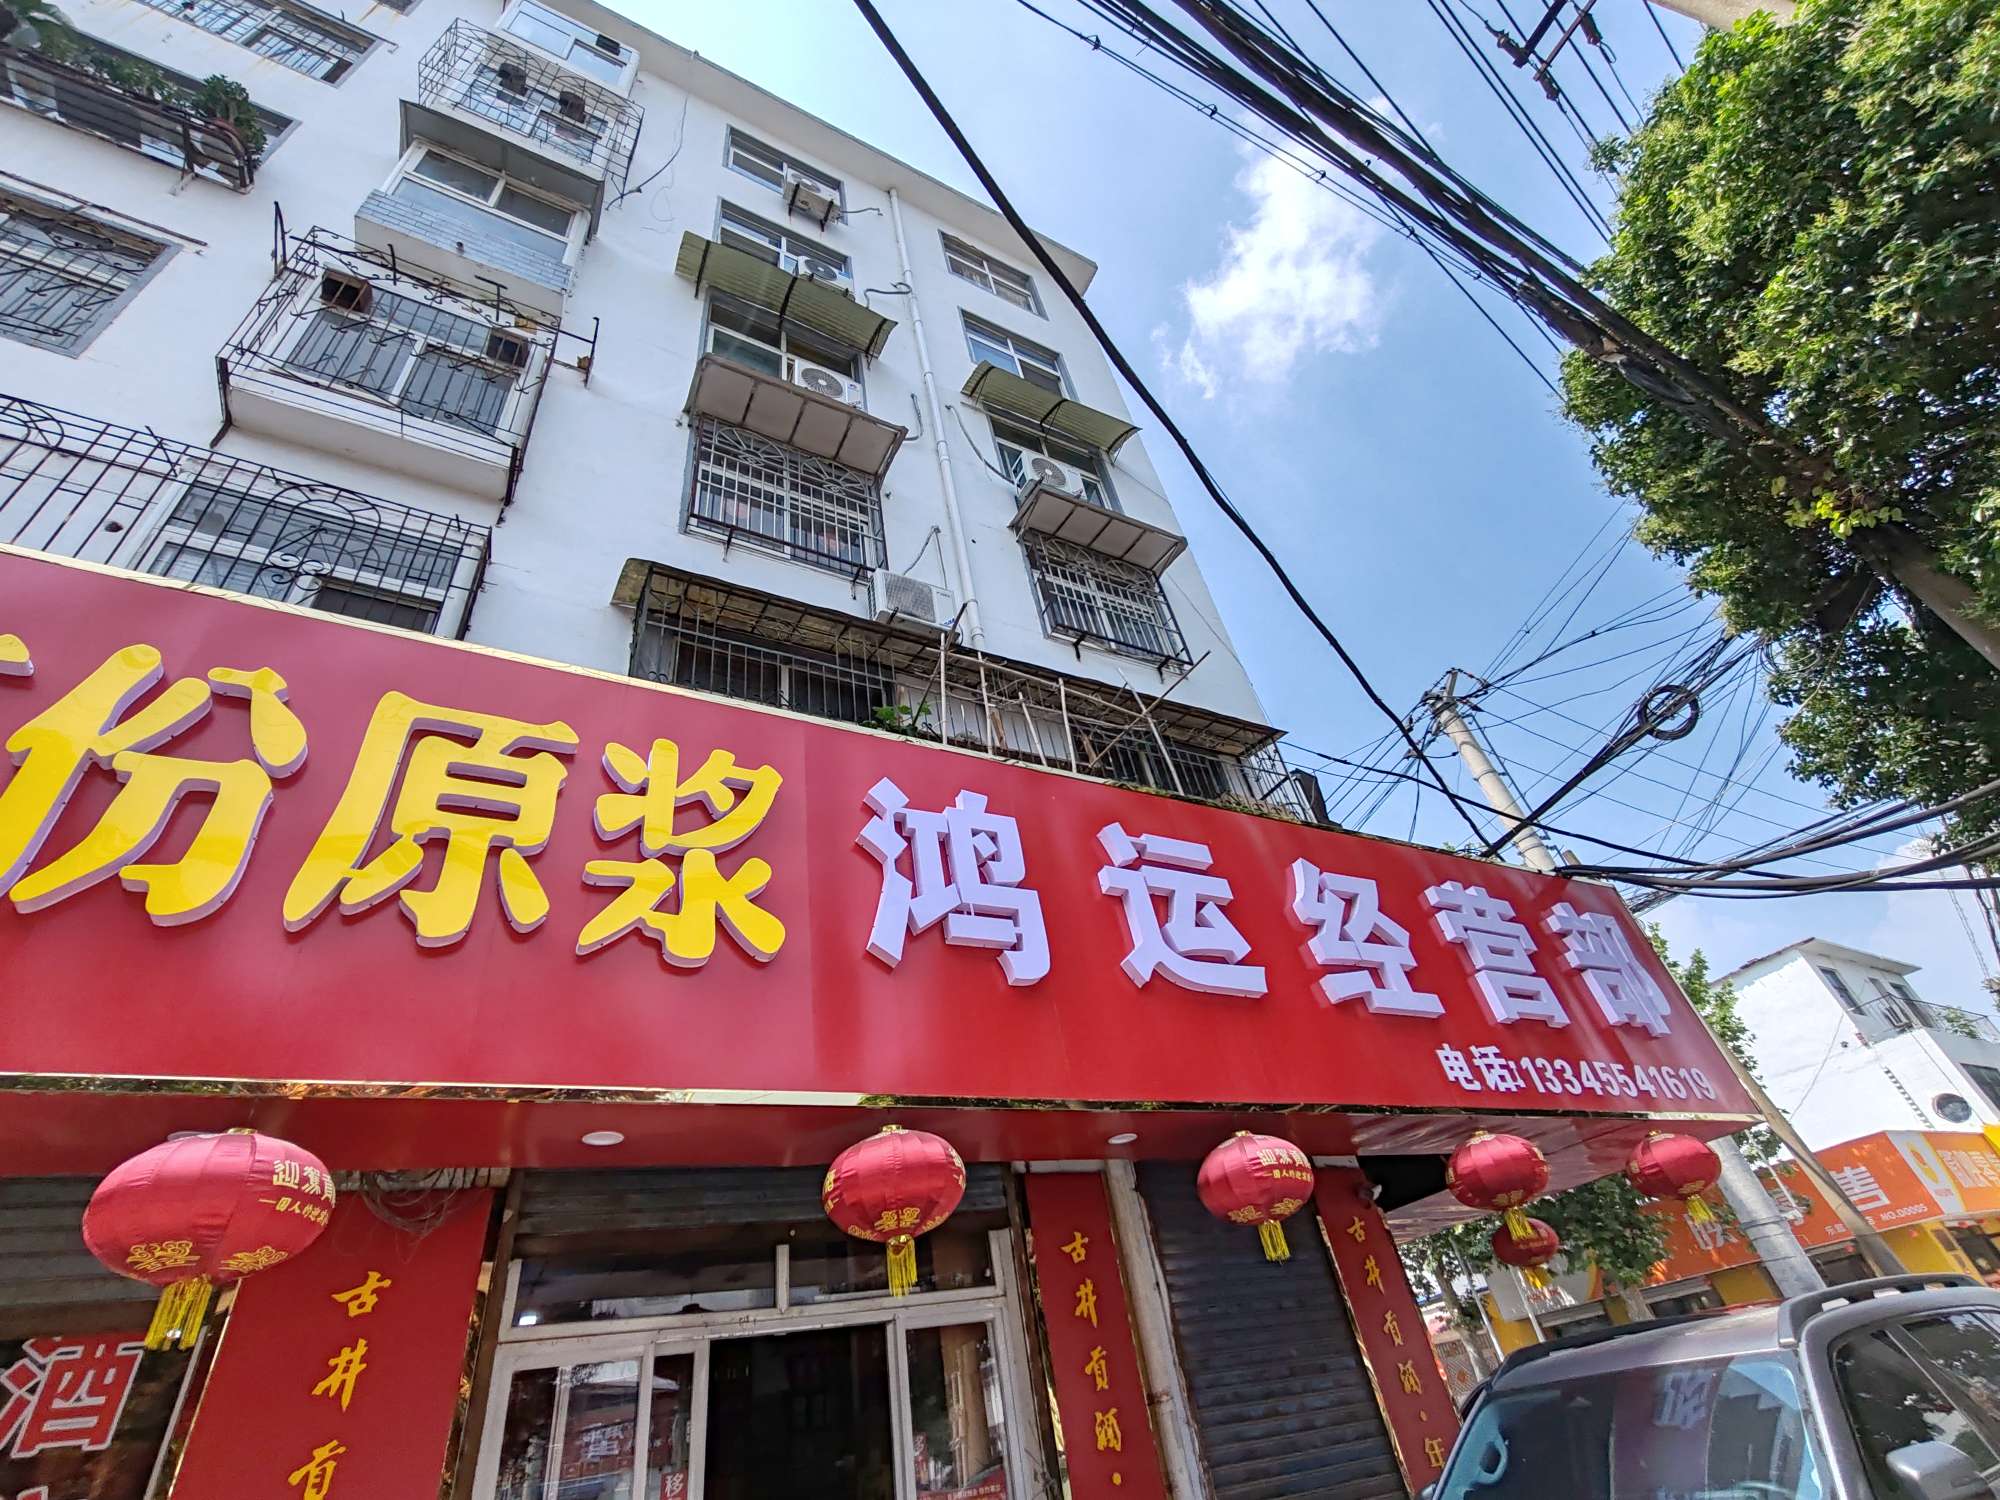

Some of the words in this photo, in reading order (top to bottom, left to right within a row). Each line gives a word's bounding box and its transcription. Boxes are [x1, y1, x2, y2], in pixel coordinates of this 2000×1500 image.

[0, 633, 786, 970] 份原浆
[855, 776, 1672, 1038] 鸿运经营部
[1437, 1043, 1716, 1099] 电话:13345541619
